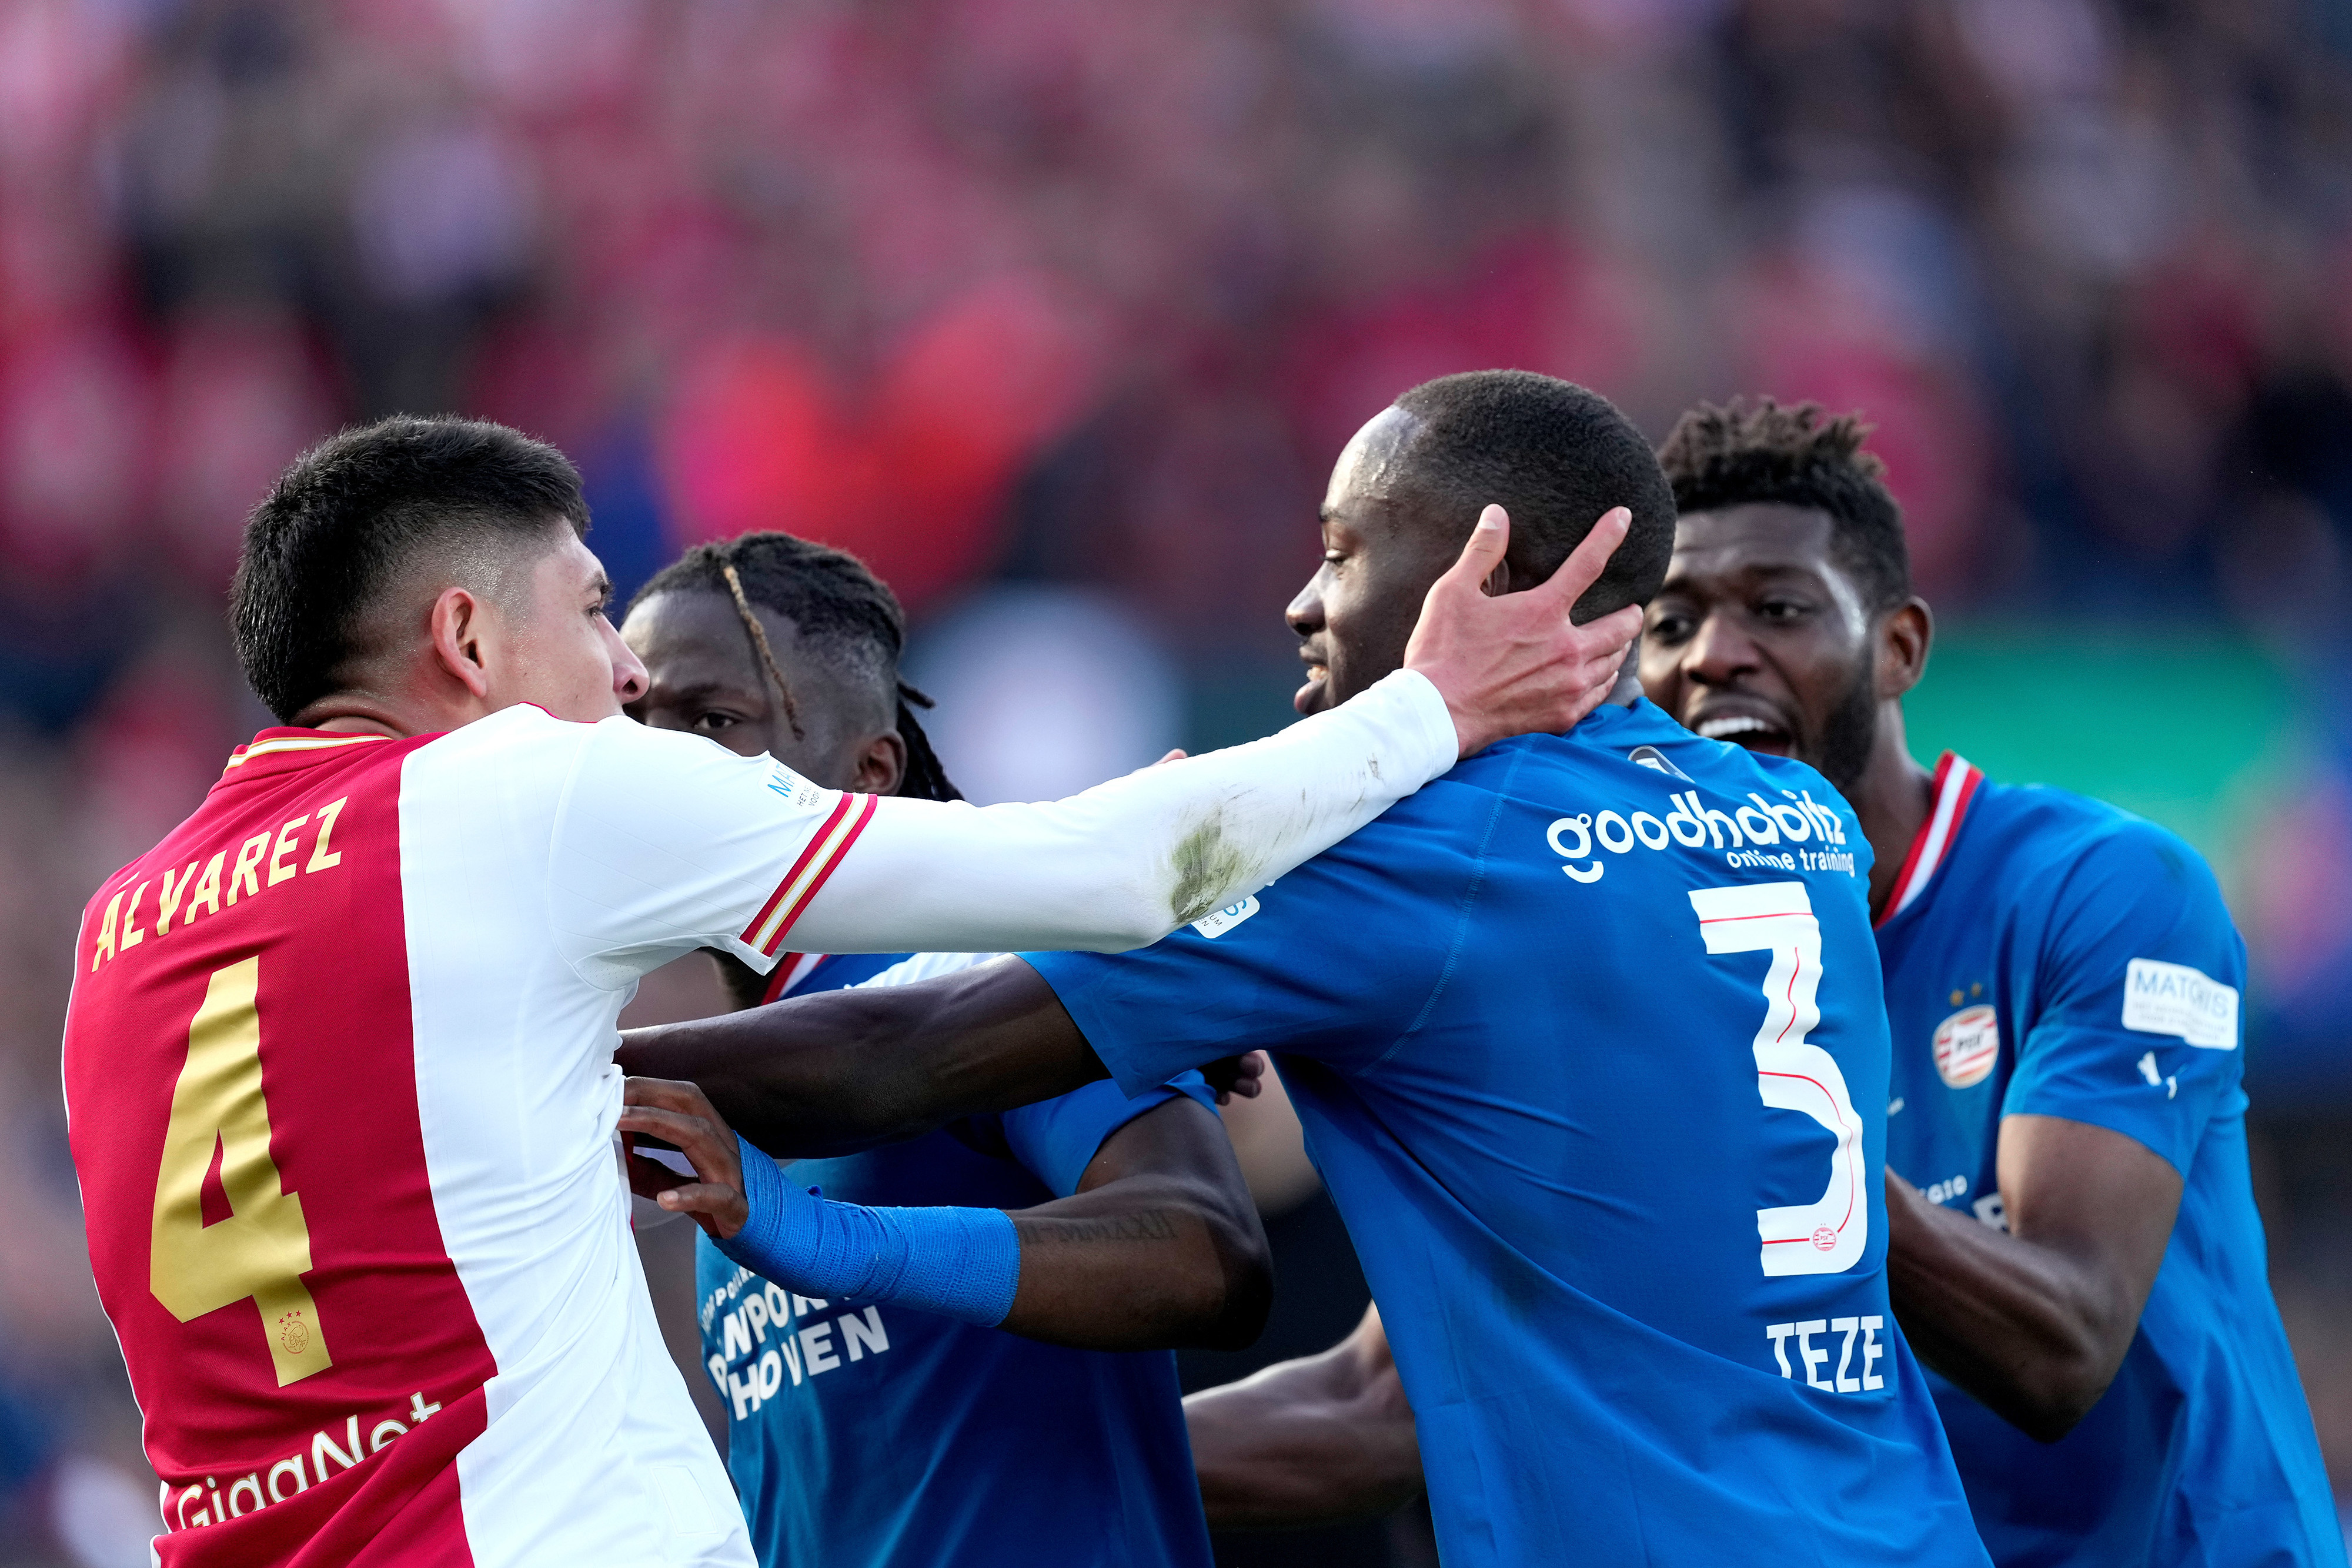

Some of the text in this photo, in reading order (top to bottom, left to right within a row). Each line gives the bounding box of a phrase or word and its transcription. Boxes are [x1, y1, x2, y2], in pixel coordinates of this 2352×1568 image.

[91, 795, 348, 972] ÁLVAREZ
[1546, 790, 1846, 884] goodhabitz
[1727, 847, 1855, 878] online training
[1688, 881, 1868, 1276] 3
[150, 955, 333, 1388] 4
[1766, 1316, 1883, 1393] TEZE
